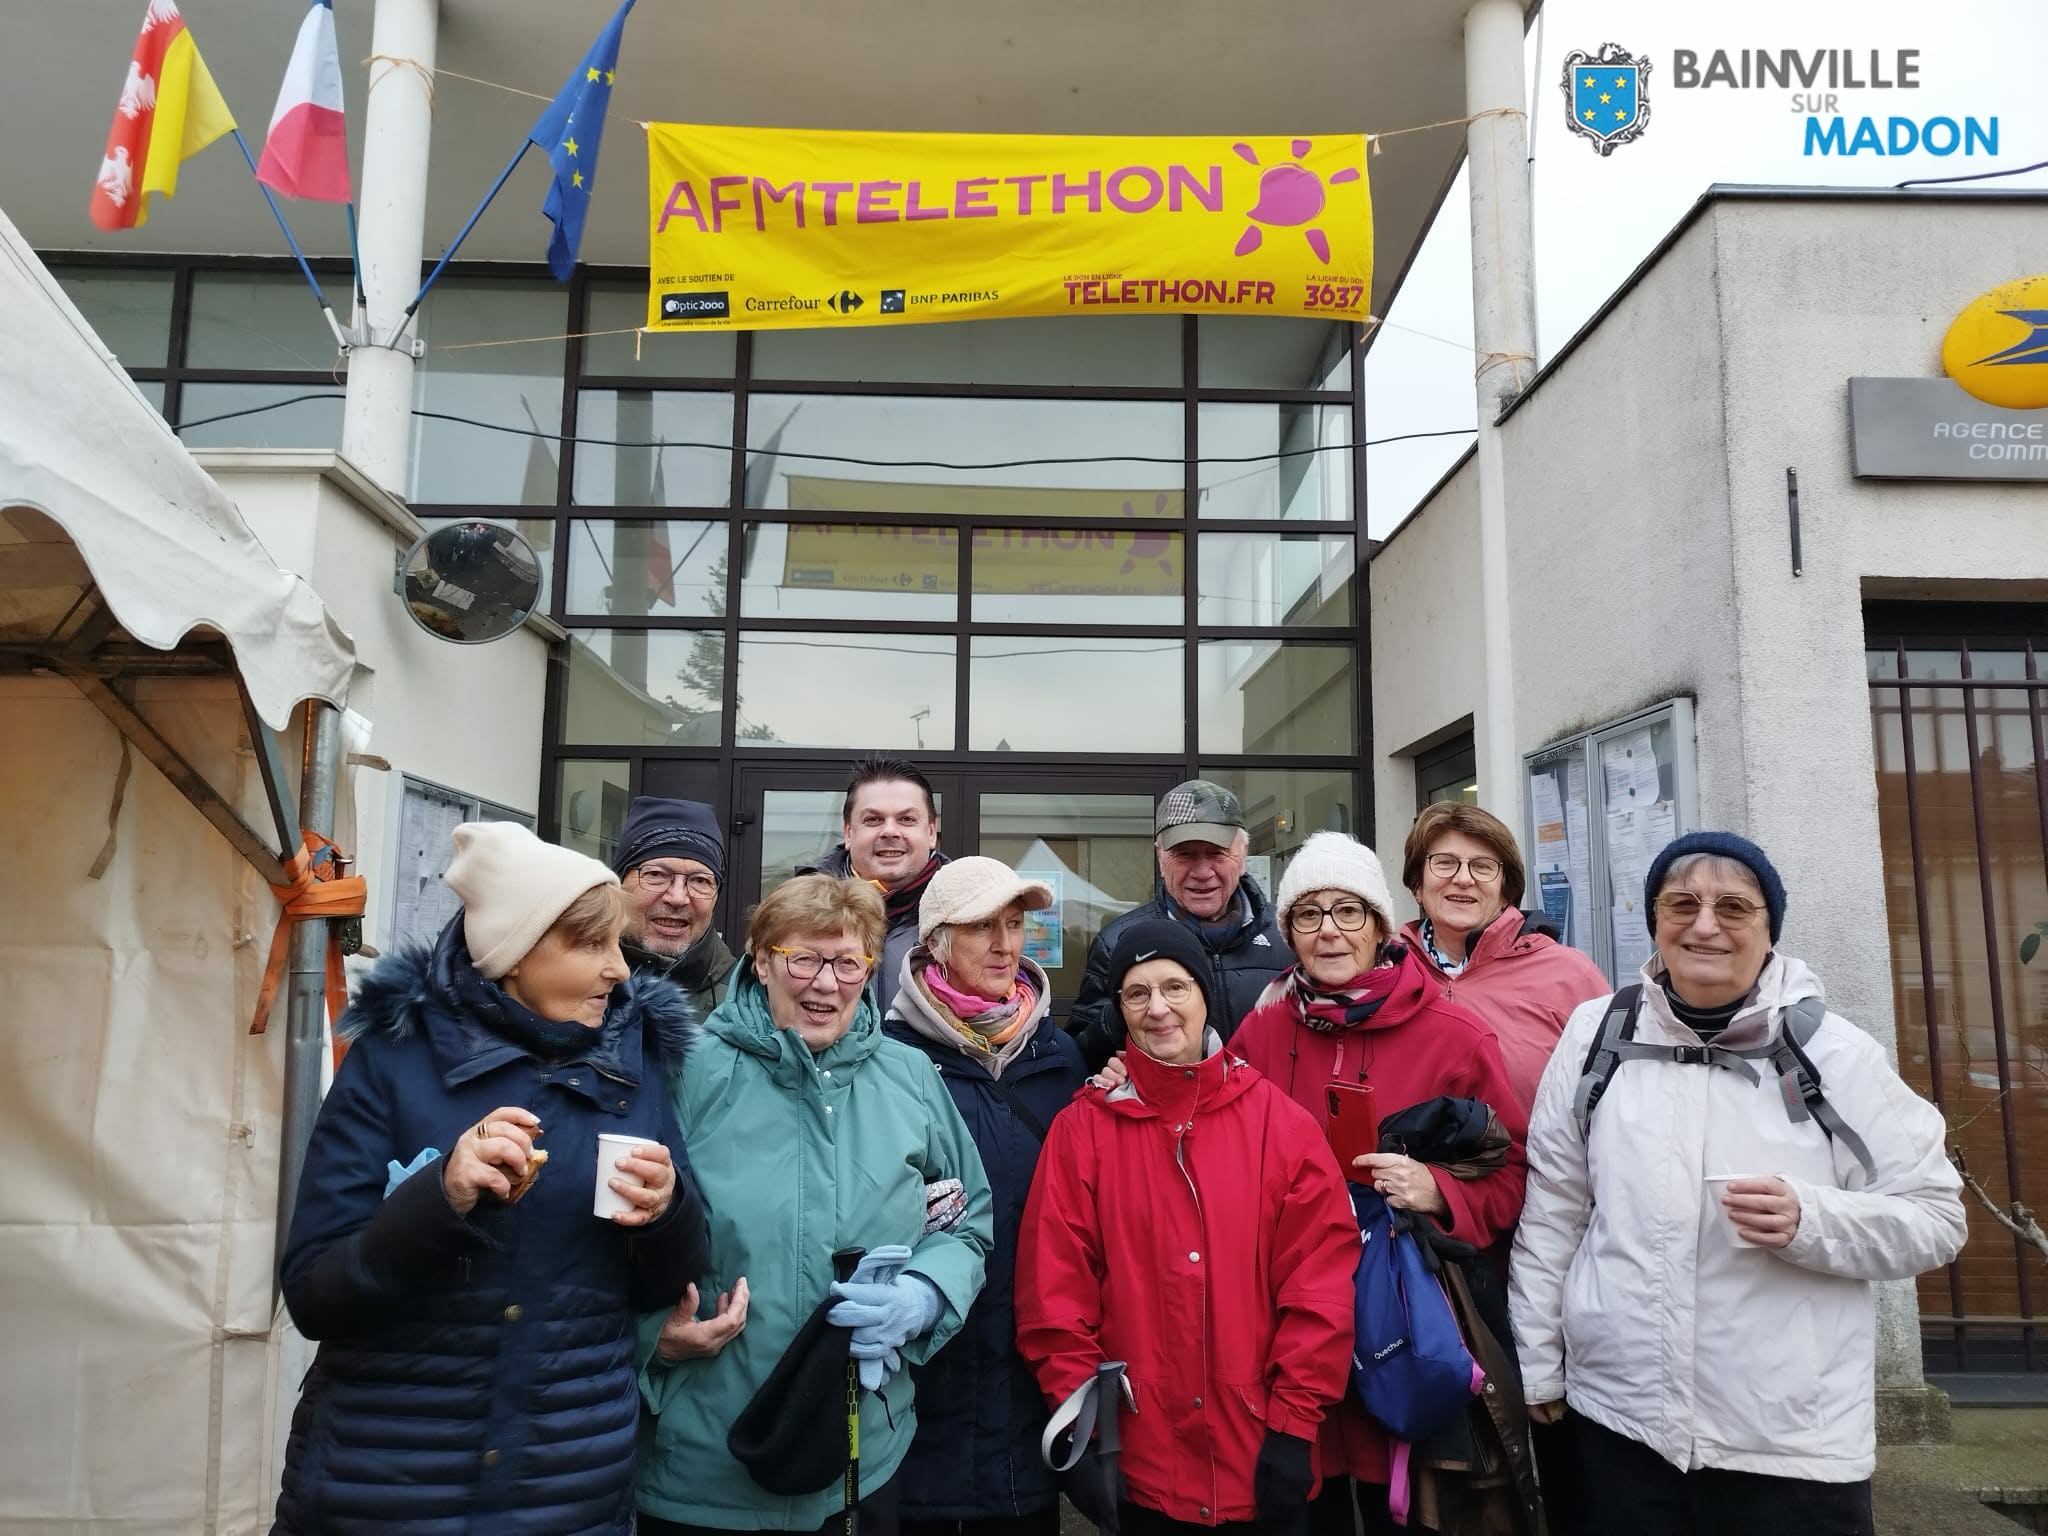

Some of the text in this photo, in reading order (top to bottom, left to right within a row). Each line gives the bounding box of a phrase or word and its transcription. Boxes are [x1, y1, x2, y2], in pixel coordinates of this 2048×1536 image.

[656, 273, 735, 285] AVEC LE SOUTIEN DE
[745, 295, 821, 312] Carrefour
[910, 290, 999, 305] BNP PARIBAS
[1303, 284, 1364, 308] 3637
[665, 299, 725, 314] Optic 2000
[1933, 421, 2044, 439] AGENCE
[1374, 1337, 1405, 1361] Quechua
